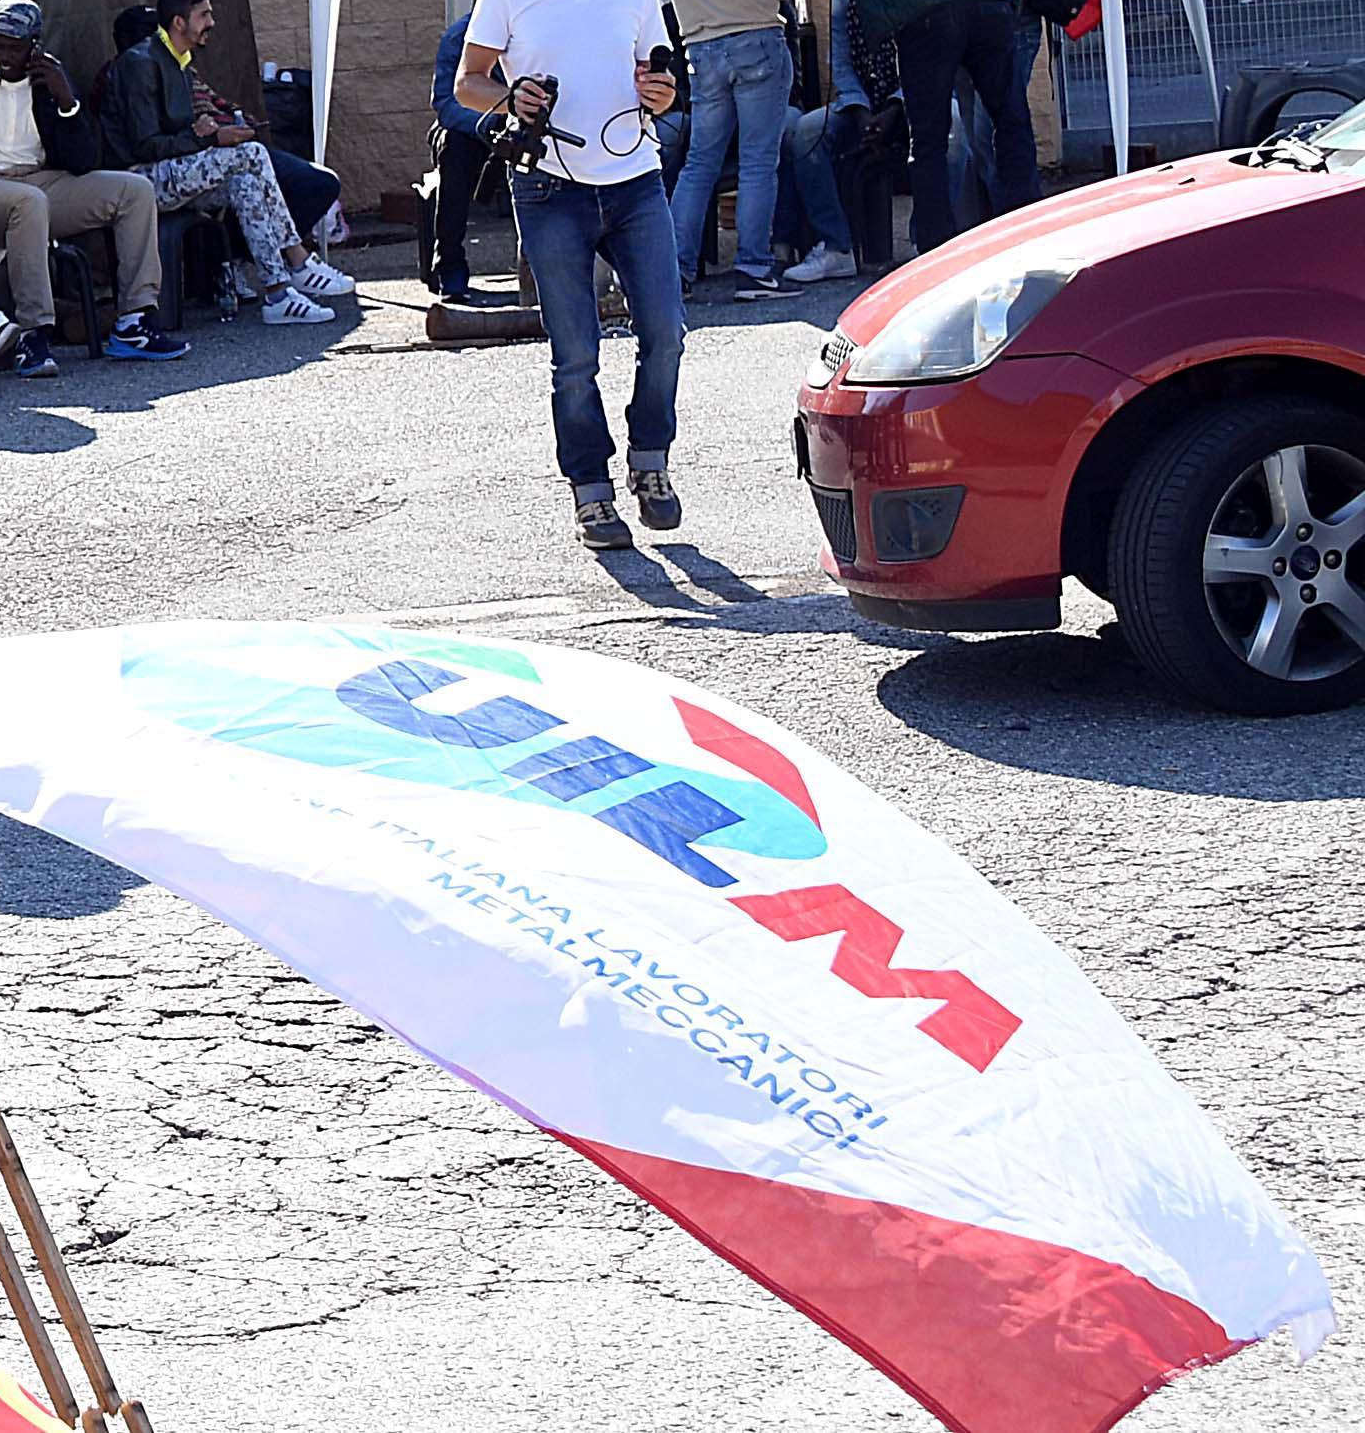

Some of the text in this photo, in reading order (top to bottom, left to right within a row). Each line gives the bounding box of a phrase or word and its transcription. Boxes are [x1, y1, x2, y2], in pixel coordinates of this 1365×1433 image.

[334, 658, 1024, 1074] UILM
[426, 871, 862, 1151] METALMECCANICI
[583, 928, 888, 1131] LAVORATORI
